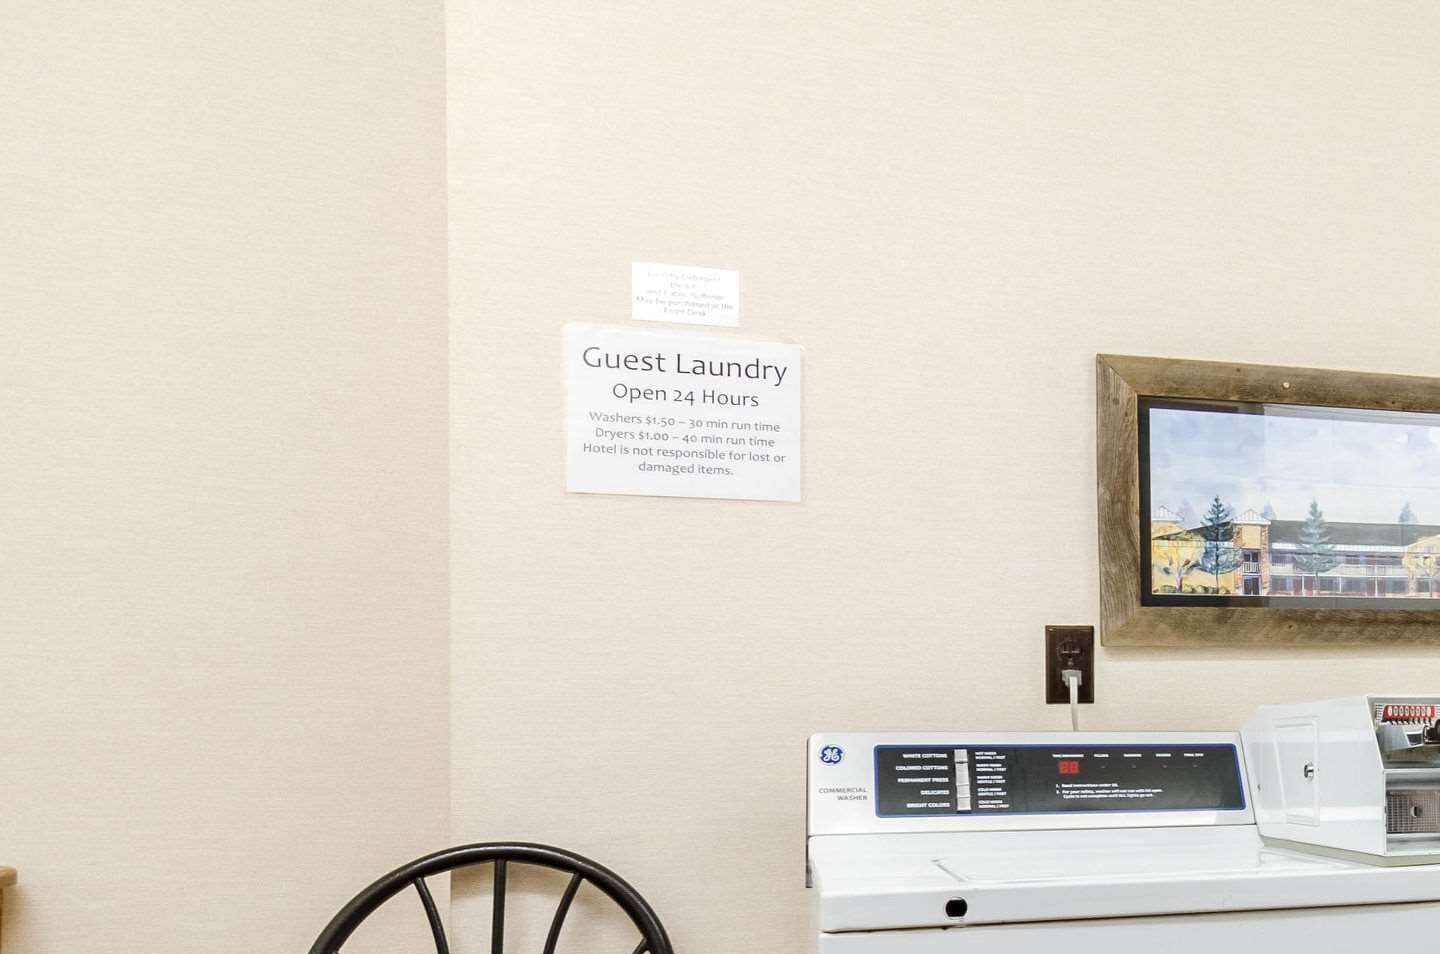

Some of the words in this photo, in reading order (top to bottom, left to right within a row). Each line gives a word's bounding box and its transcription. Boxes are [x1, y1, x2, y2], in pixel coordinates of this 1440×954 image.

[583, 347, 666, 373] Guest
[676, 353, 788, 386] Laundry
[613, 383, 666, 404] Open
[673, 389, 694, 406] 24
[702, 389, 759, 407] Hours
[589, 411, 642, 425] Washers
[646, 416, 675, 428] $1.50
[689, 419, 703, 429] 30
[706, 419, 728, 430] min
[731, 422, 751, 431] run
[754, 422, 780, 433] time
[595, 428, 635, 442] Dryers
[638, 431, 669, 442] $1.00
[682, 434, 697, 444] 40
[701, 434, 723, 445] min
[726, 437, 745, 446] run
[749, 437, 775, 447] time
[583, 443, 616, 455] Hotel
[620, 445, 629, 455] is
[633, 446, 653, 457] not
[657, 447, 726, 461] responsible
[729, 450, 746, 462] for
[749, 452, 770, 463] lost
[773, 454, 786, 464] or
[638, 461, 694, 476] damaged
[698, 464, 733, 476] items.
